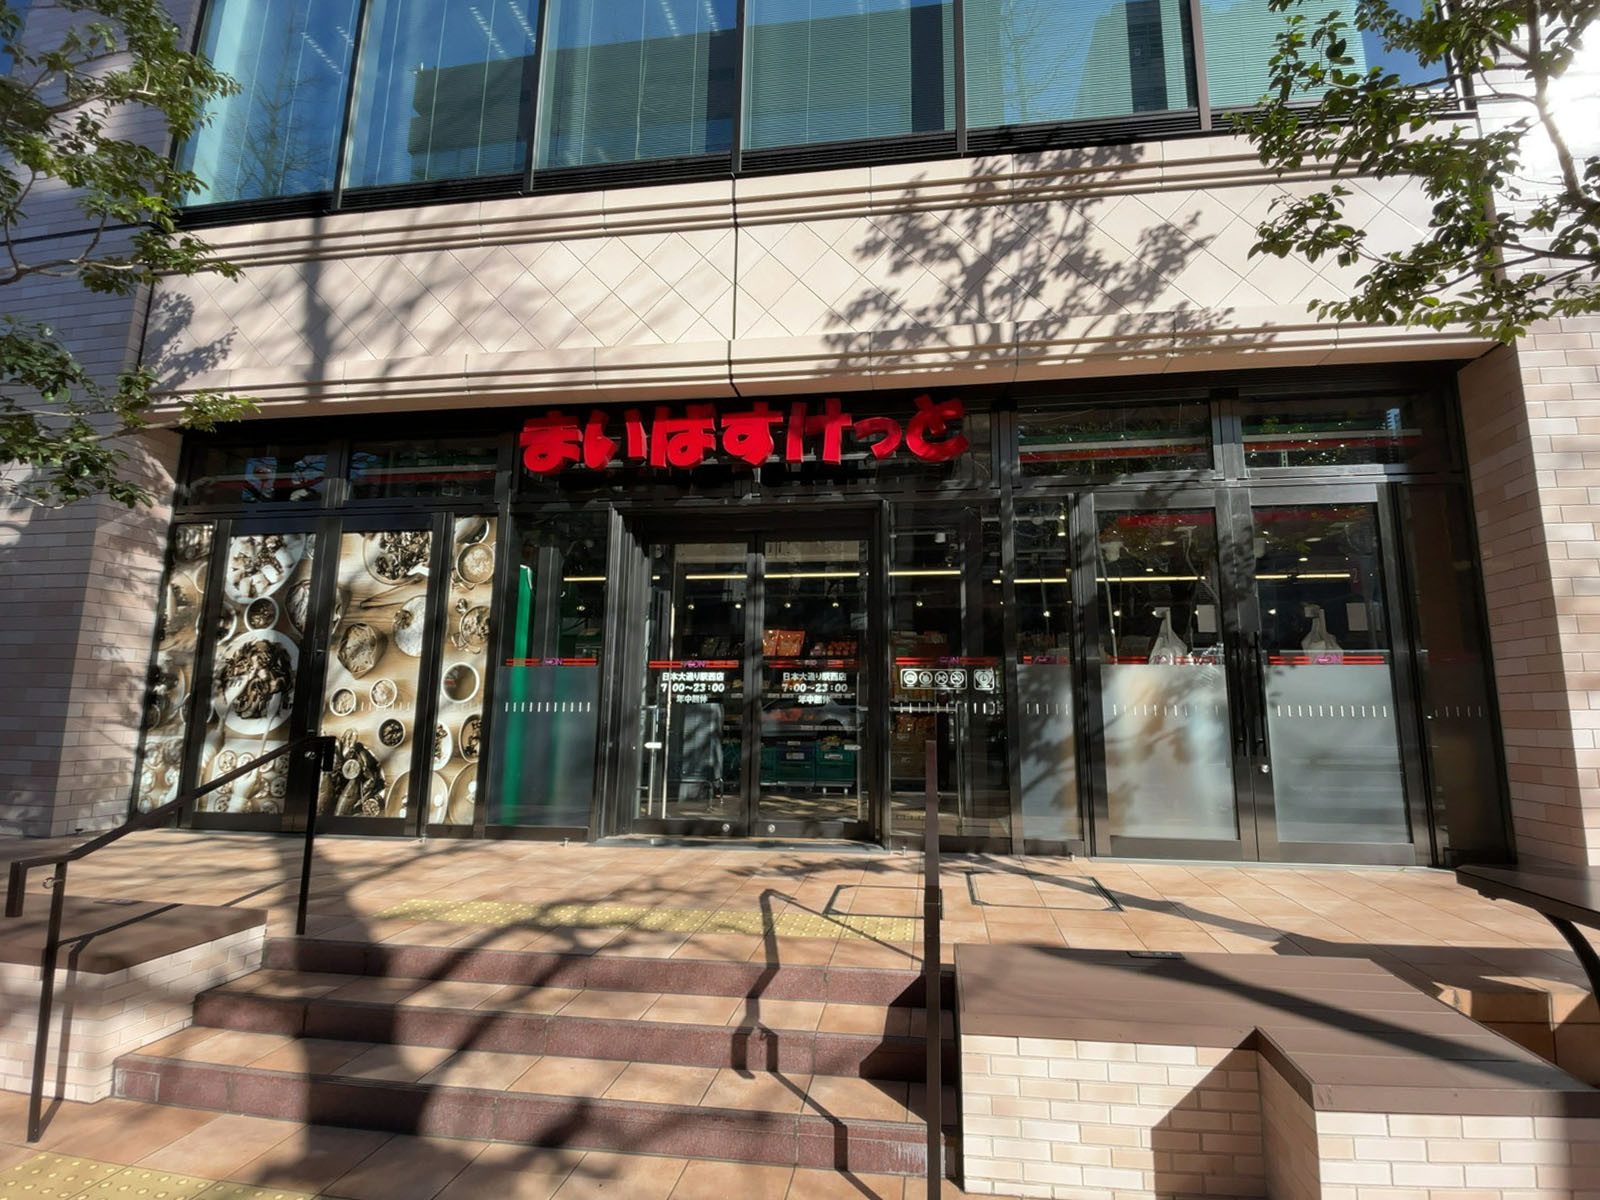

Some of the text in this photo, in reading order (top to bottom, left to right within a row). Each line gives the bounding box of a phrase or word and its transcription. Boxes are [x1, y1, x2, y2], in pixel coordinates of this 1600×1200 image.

[518, 394, 969, 475] まいばすけっと
